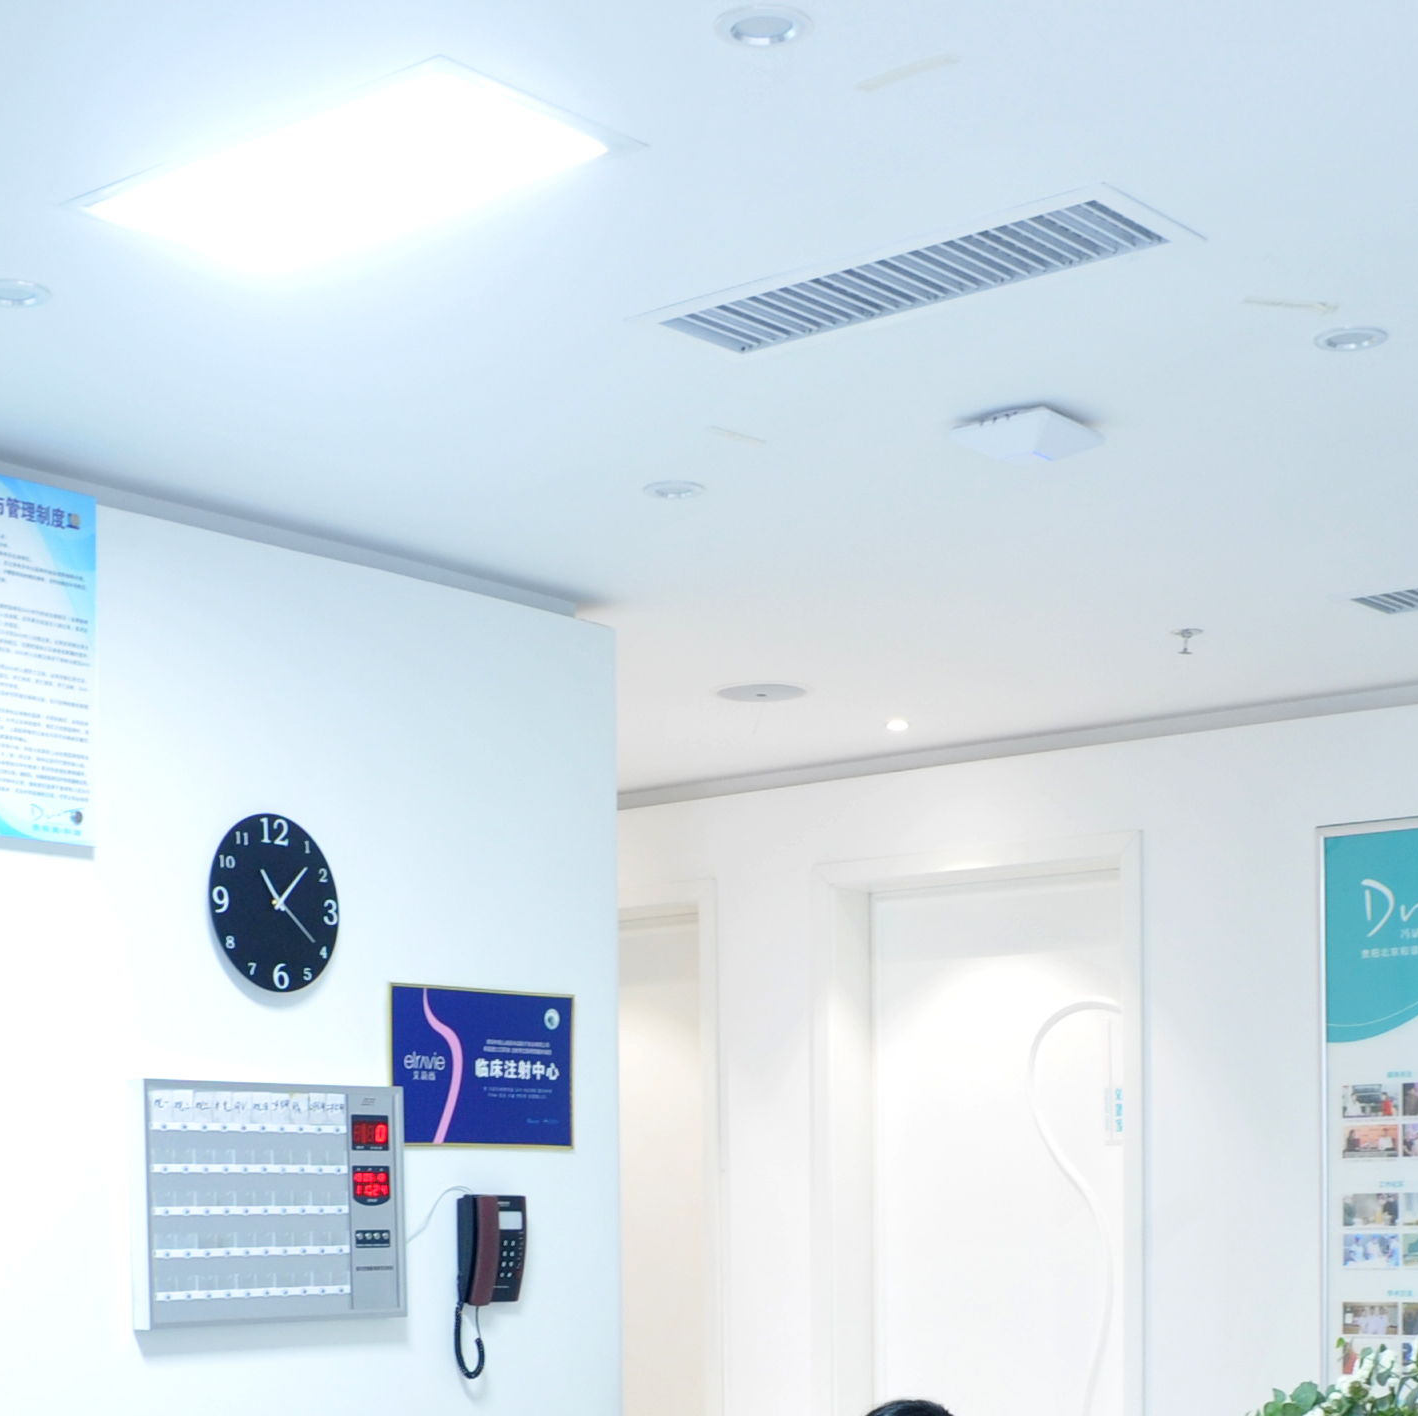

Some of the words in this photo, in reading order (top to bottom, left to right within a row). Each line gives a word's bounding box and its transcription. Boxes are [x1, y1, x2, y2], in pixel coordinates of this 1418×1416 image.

[235, 831, 249, 846] 11
[259, 817, 289, 847] 12
[304, 840, 311, 854] 1
[219, 854, 236, 869] 10
[318, 868, 328, 883] 2
[212, 886, 229, 913] 9
[323, 899, 338, 926] 3
[225, 935, 236, 949] 8
[319, 946, 328, 959] 4
[247, 962, 257, 975] 7
[273, 963, 290, 989] 6
[303, 968, 313, 981] 5
[475, 1058, 560, 1081] 临床注射中心
